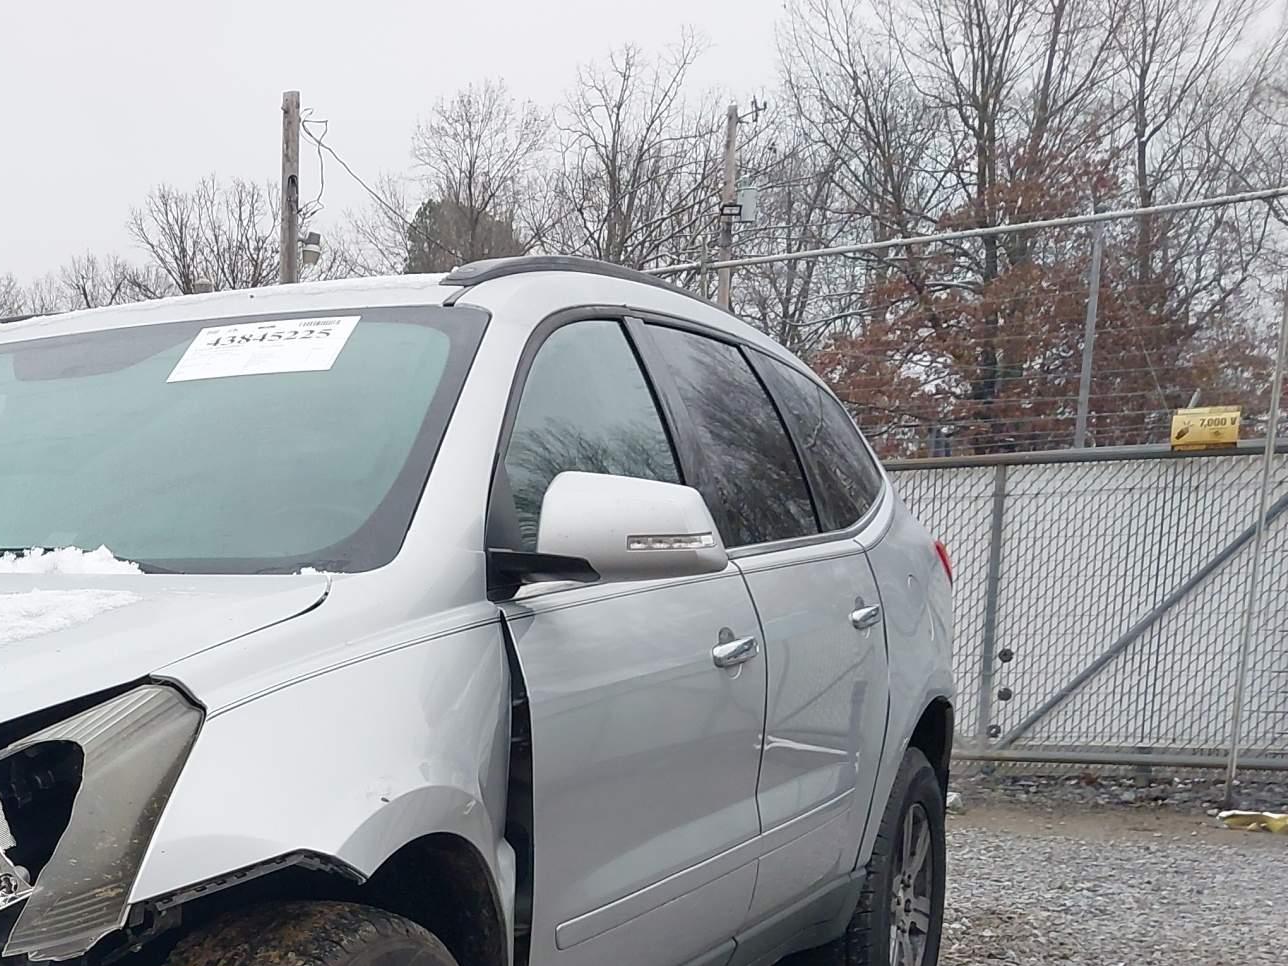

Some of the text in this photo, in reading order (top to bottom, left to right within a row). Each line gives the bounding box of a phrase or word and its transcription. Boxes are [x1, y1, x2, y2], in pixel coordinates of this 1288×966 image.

[206, 328, 333, 346] 43845225
[1199, 417, 1237, 428] 7,000 V
